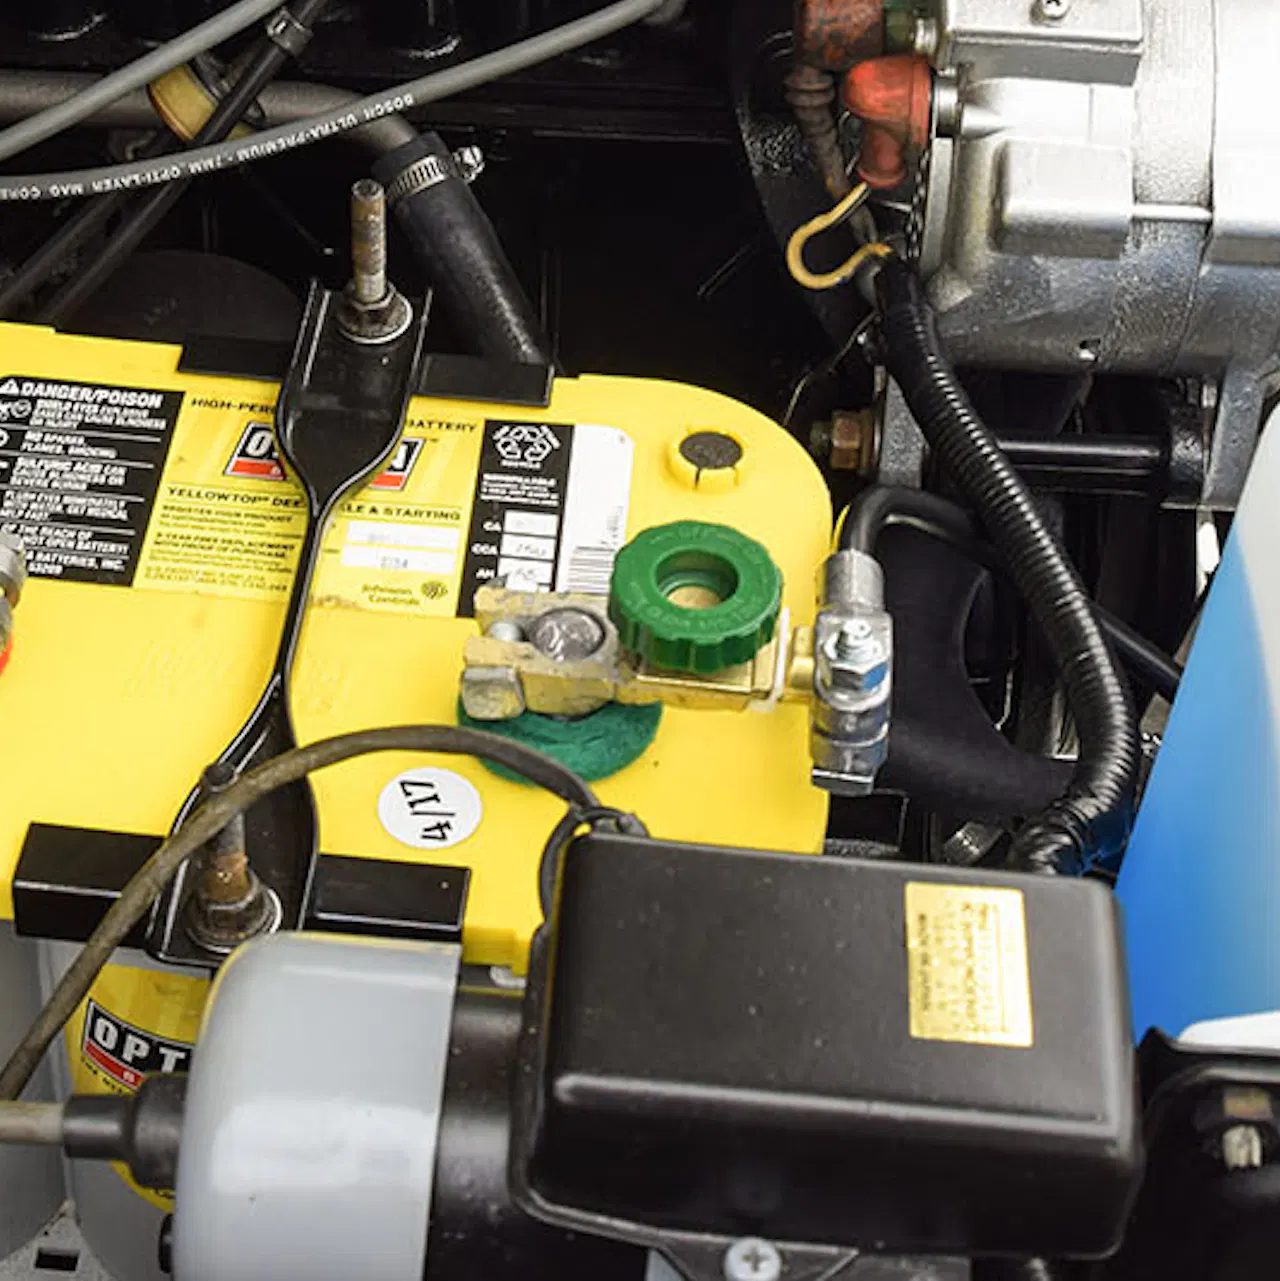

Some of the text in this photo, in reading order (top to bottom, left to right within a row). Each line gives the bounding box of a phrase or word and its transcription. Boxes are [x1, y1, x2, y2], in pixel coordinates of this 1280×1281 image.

[363, 93, 414, 119] BOSCH
[91, 164, 181, 191] OPTI-LAYER
[48, 183, 84, 198] MAG
[20, 381, 163, 408] DANGER/POISON
[191, 397, 276, 414] HIGH-PER
[24, 430, 44, 442] NO
[272, 497, 304, 508] DEE
[383, 508, 461, 520] STARTING
[483, 521, 502, 532] CA
[471, 543, 498, 556] CCA
[361, 583, 412, 595] Johnson
[369, 594, 420, 606] Controls
[94, 1016, 186, 1074] OPT
